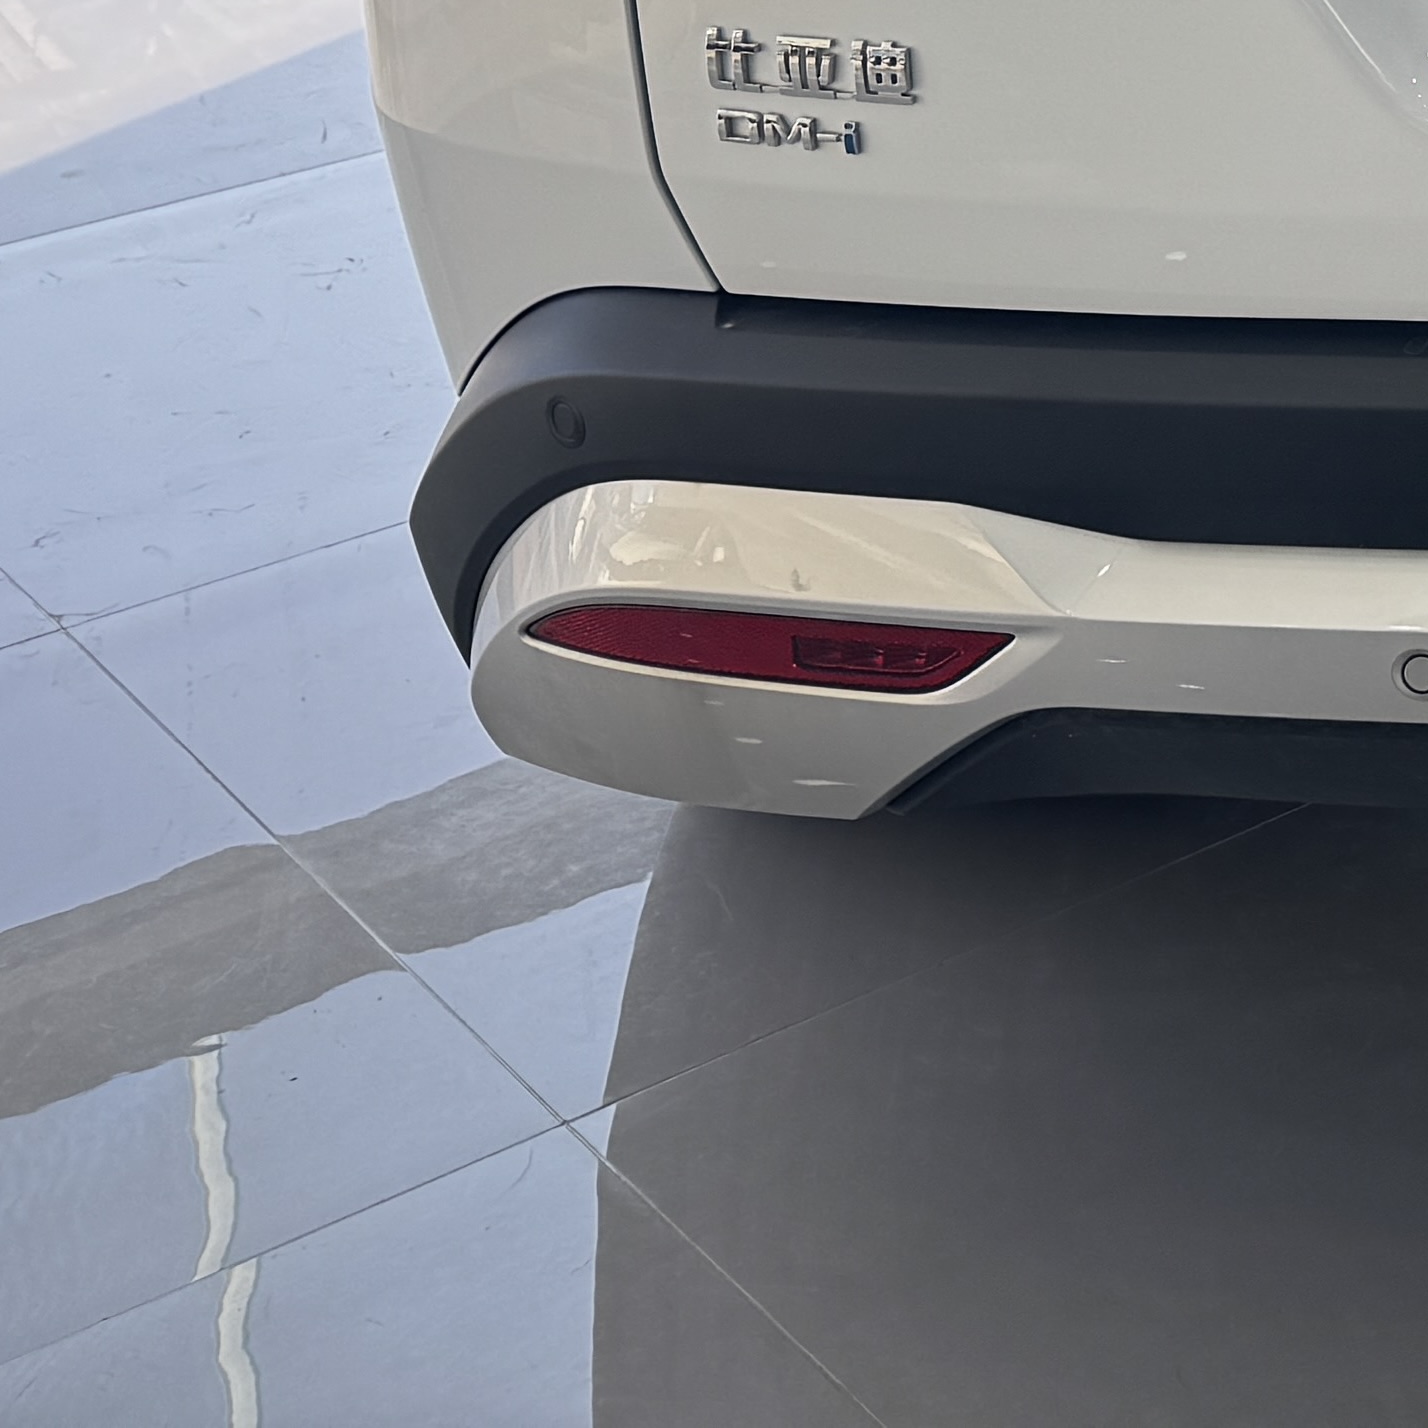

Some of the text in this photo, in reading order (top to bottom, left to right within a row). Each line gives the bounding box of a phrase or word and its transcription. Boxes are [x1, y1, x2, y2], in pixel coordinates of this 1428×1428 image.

[705, 25, 917, 105] 比亚迪
[716, 107, 862, 155] DM-i
